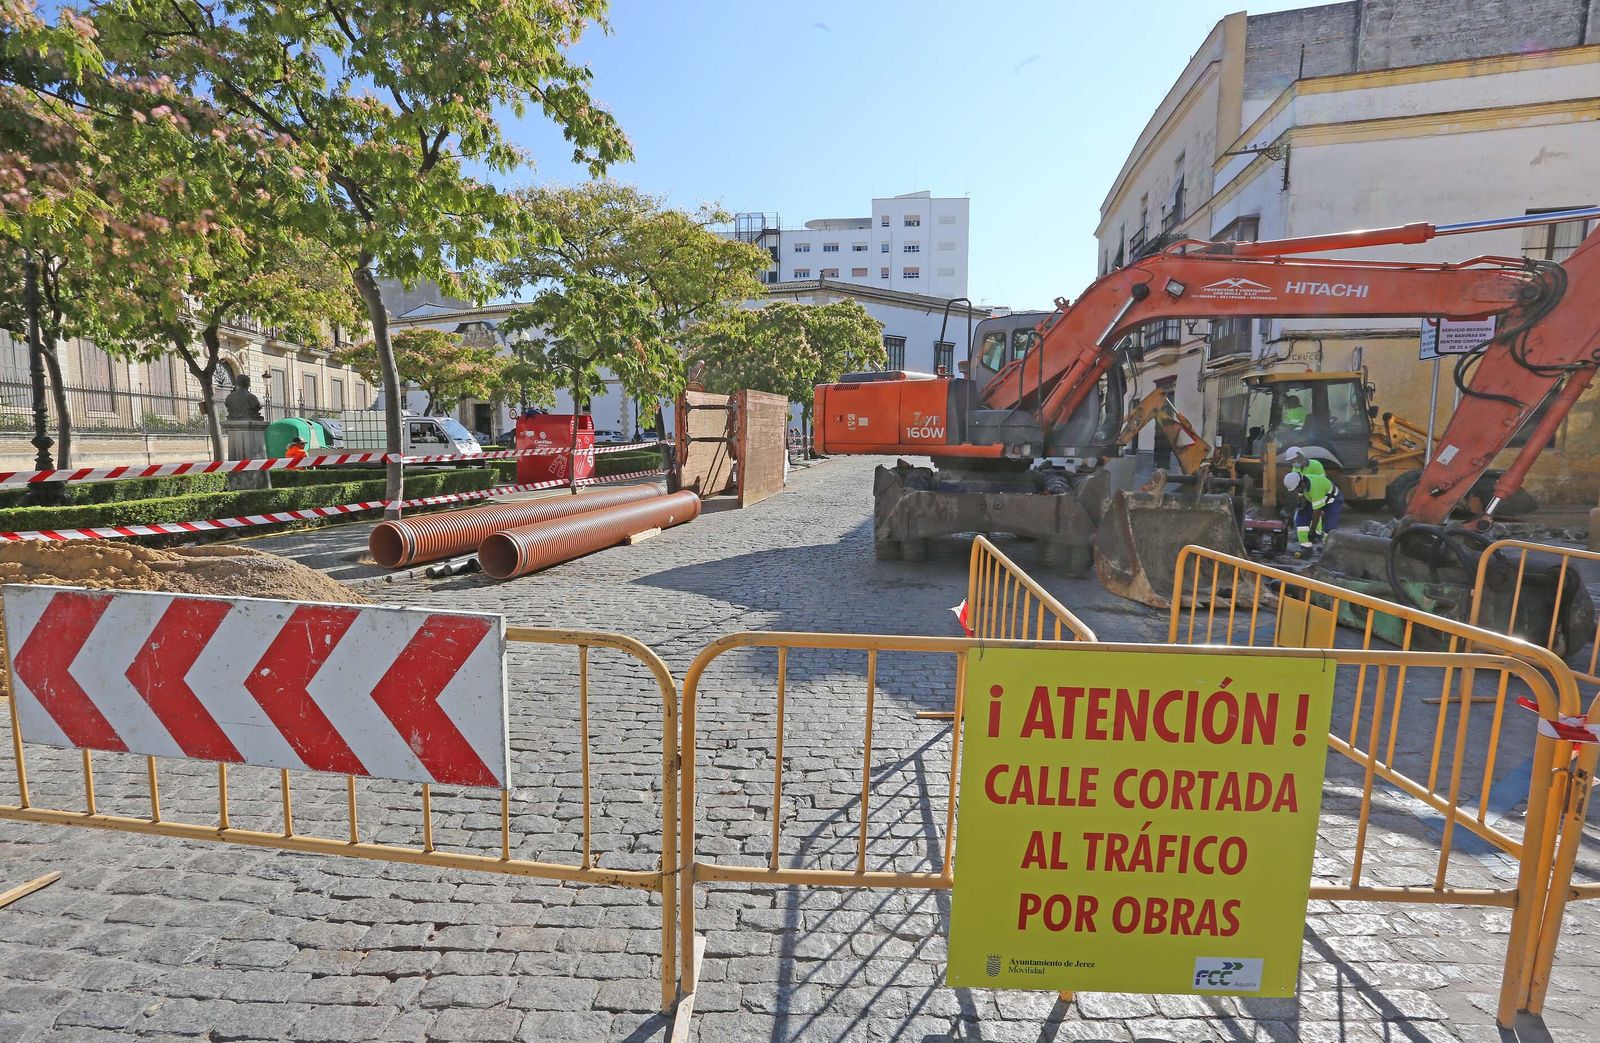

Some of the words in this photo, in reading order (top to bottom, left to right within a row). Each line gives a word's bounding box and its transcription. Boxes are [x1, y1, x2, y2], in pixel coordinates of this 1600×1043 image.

[1284, 281, 1368, 298] HITACHI
[906, 427, 944, 438] 160W
[1020, 676, 1280, 746] ATENCIÓN
[1293, 694, 1310, 746] !
[984, 764, 1099, 807] CALLE
[1113, 768, 1298, 813] CORTADA
[1020, 830, 1069, 870] AL
[1083, 821, 1248, 876] TRÁFICO
[1017, 893, 1099, 933] POR
[1112, 896, 1241, 937] OBRAS
[1008, 958, 1062, 967] Ayuntamiento
[1195, 970, 1232, 986] FCC
